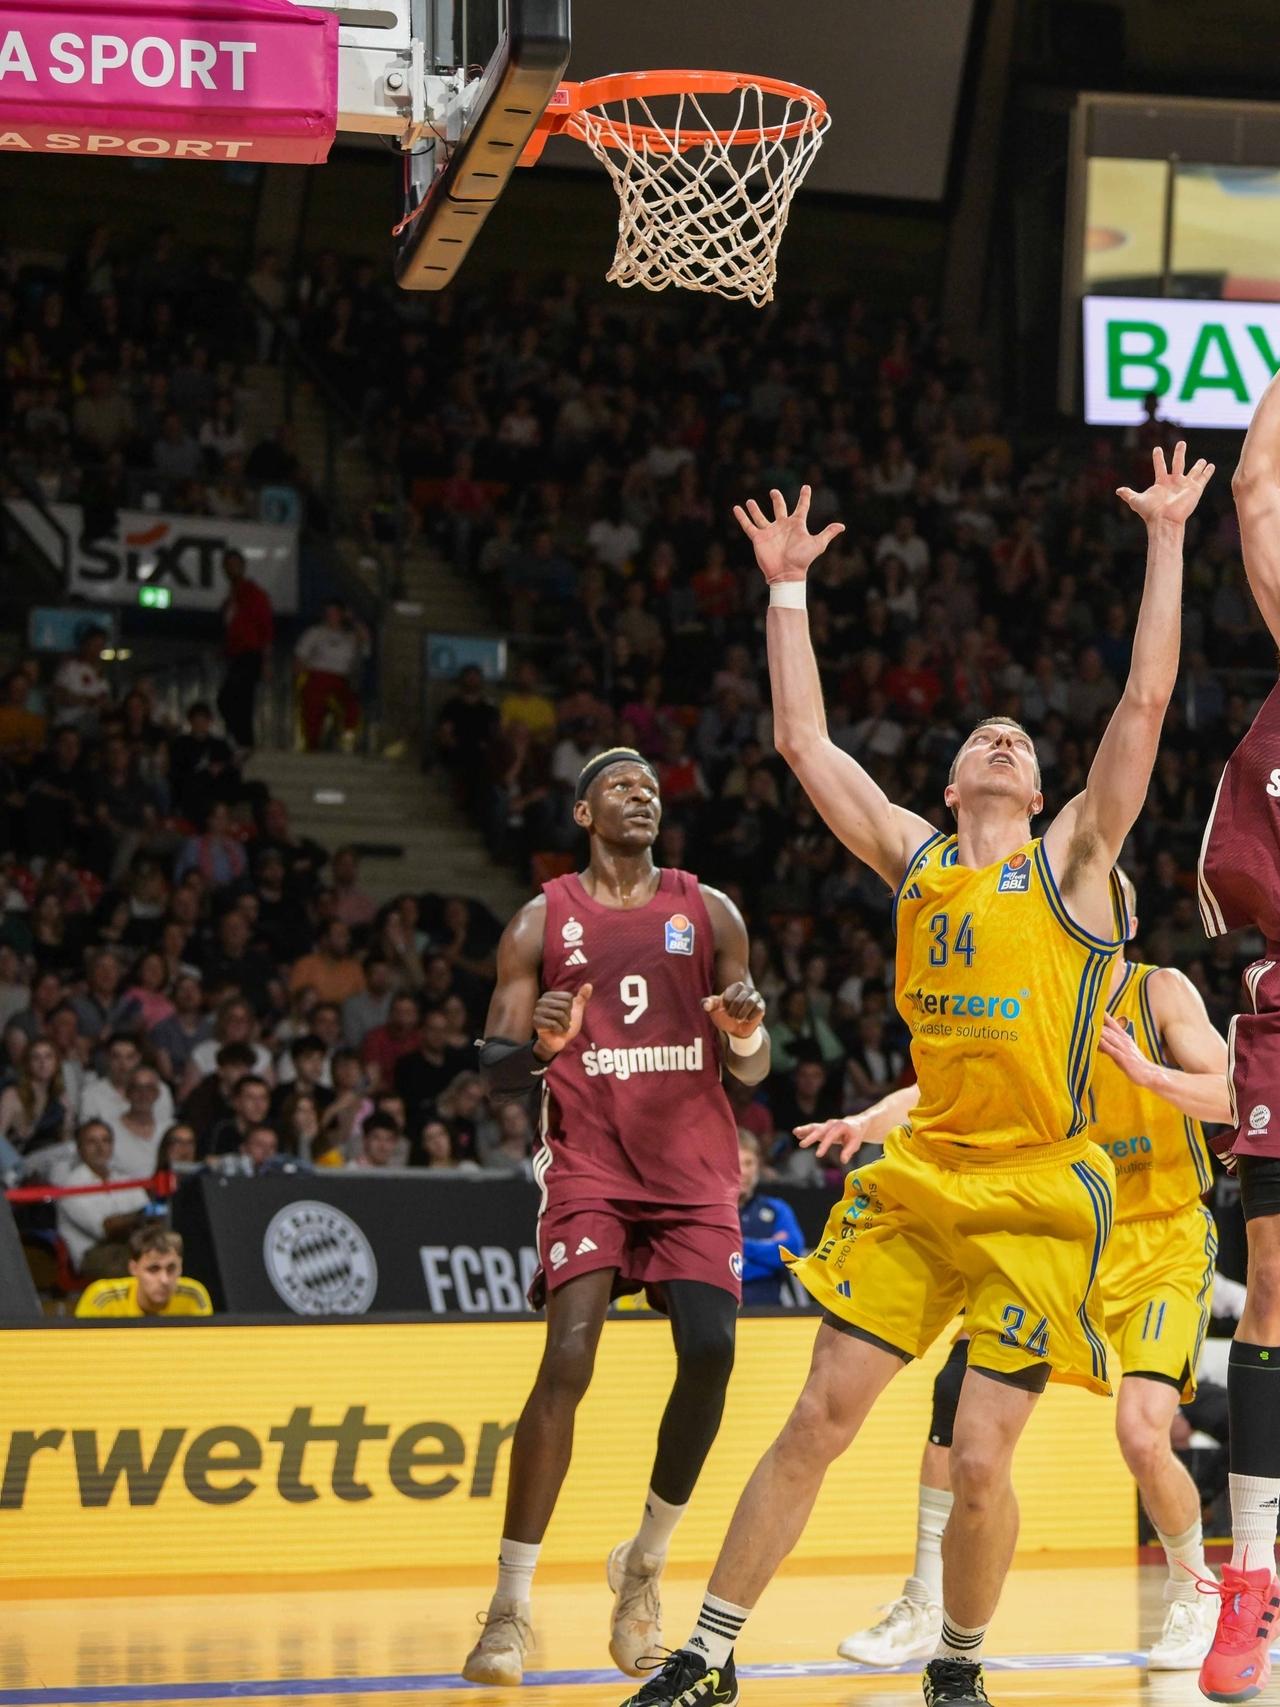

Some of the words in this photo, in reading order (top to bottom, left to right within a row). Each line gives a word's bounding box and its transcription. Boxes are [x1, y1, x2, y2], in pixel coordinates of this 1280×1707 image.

[49, 32, 257, 91] SPORT
[45, 133, 253, 158] SPORT
[1000, 880, 1025, 890] BBL
[929, 913, 976, 967] 34
[619, 975, 648, 1025] 9
[905, 987, 1021, 1019] terzero
[956, 1026, 1018, 1041] solutions
[582, 1037, 704, 1080] segmund
[999, 1303, 1050, 1357] 34
[1141, 1301, 1167, 1340] 11
